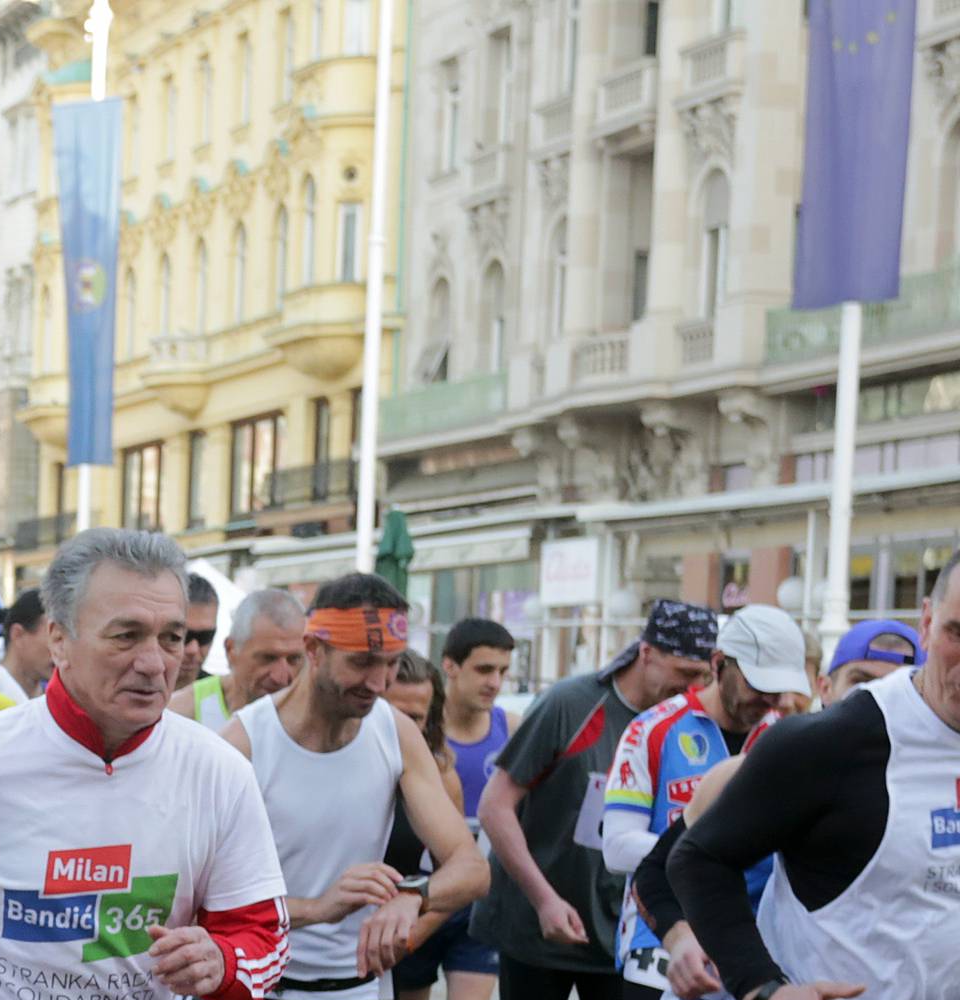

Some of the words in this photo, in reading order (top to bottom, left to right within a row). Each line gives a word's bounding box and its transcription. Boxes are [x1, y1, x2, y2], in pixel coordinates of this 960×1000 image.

[52, 857, 124, 883] Milan
[7, 900, 93, 930] Bandić
[105, 904, 163, 935] 365
